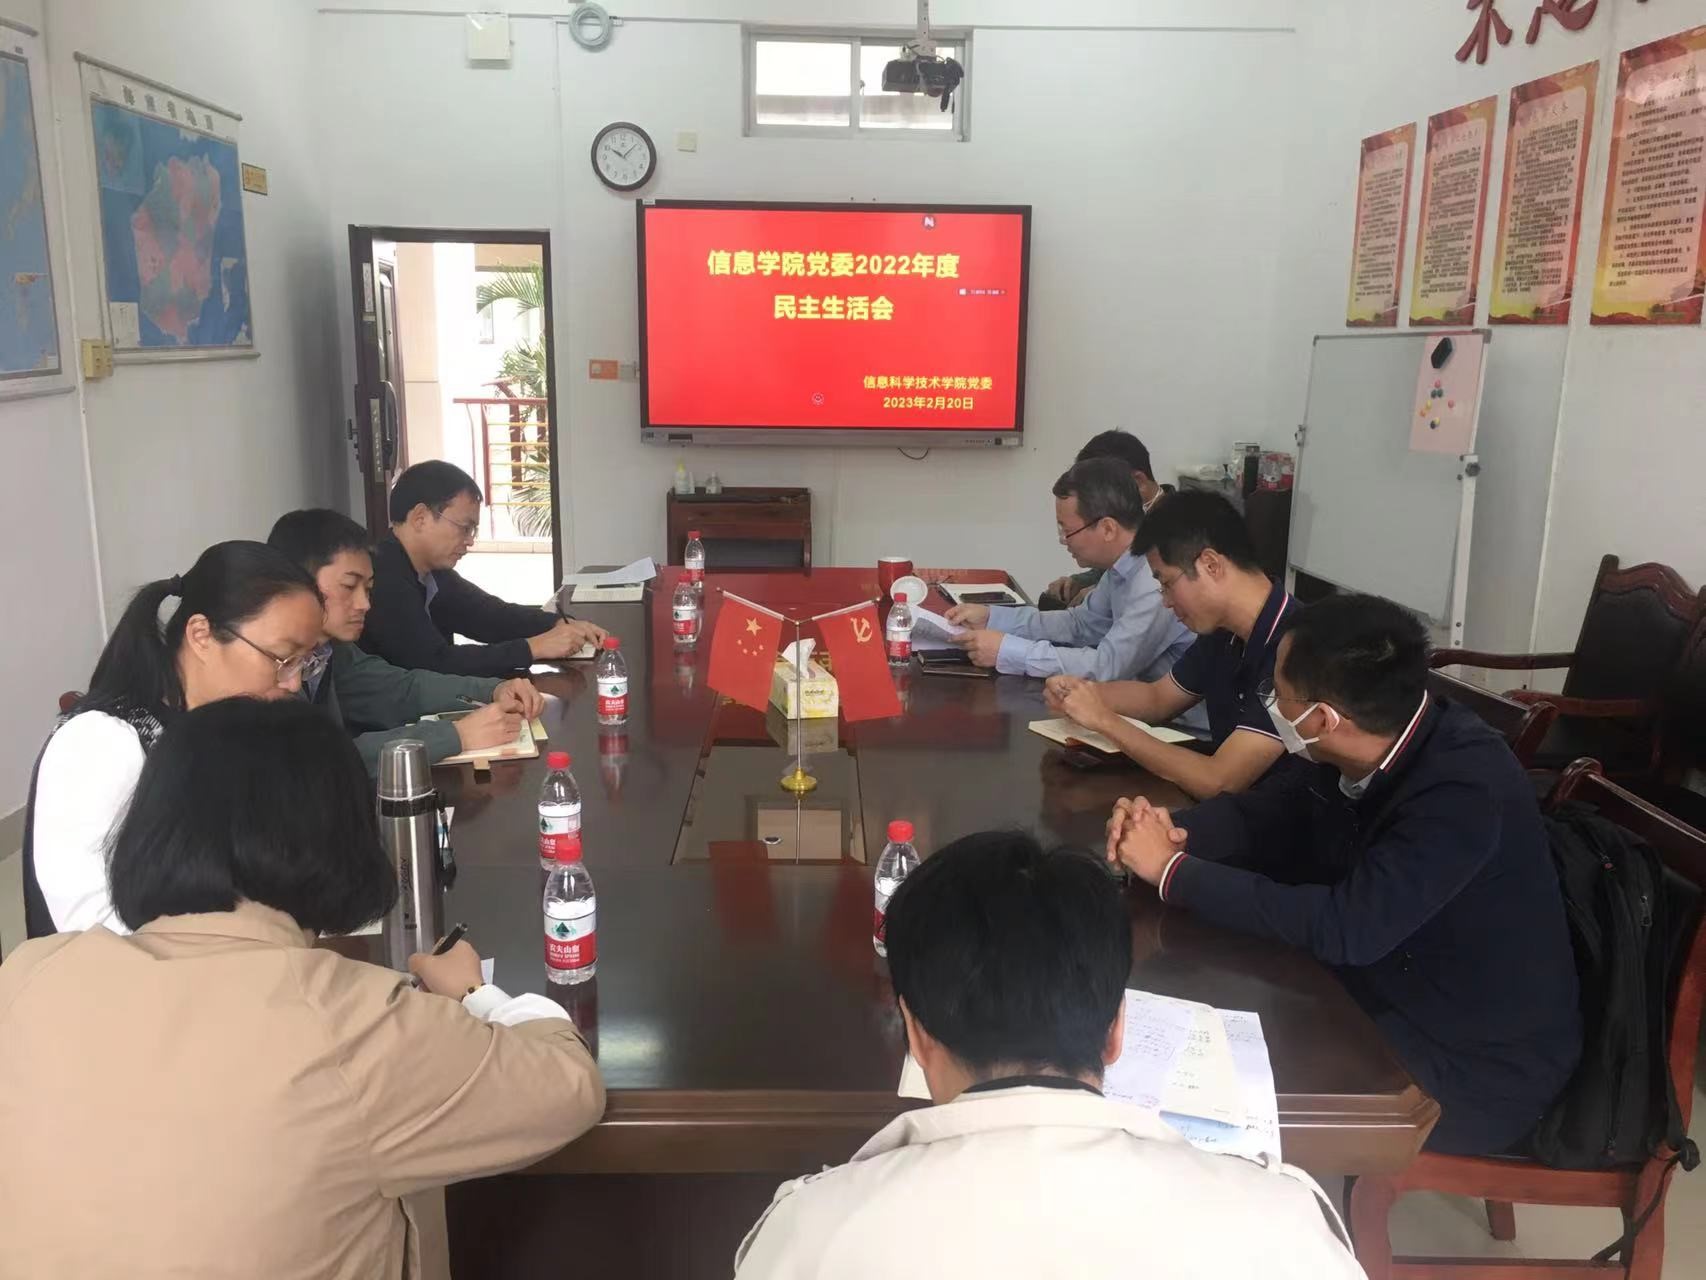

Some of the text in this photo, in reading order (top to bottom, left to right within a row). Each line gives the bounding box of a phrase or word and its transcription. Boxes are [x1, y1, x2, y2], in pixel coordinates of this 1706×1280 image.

[707, 250, 960, 279] 信息学院党委2022年度
[774, 295, 894, 321] 民主生活会
[863, 375, 993, 391] 信息科学技术学院党委
[883, 396, 974, 411] 2023年2月20日
